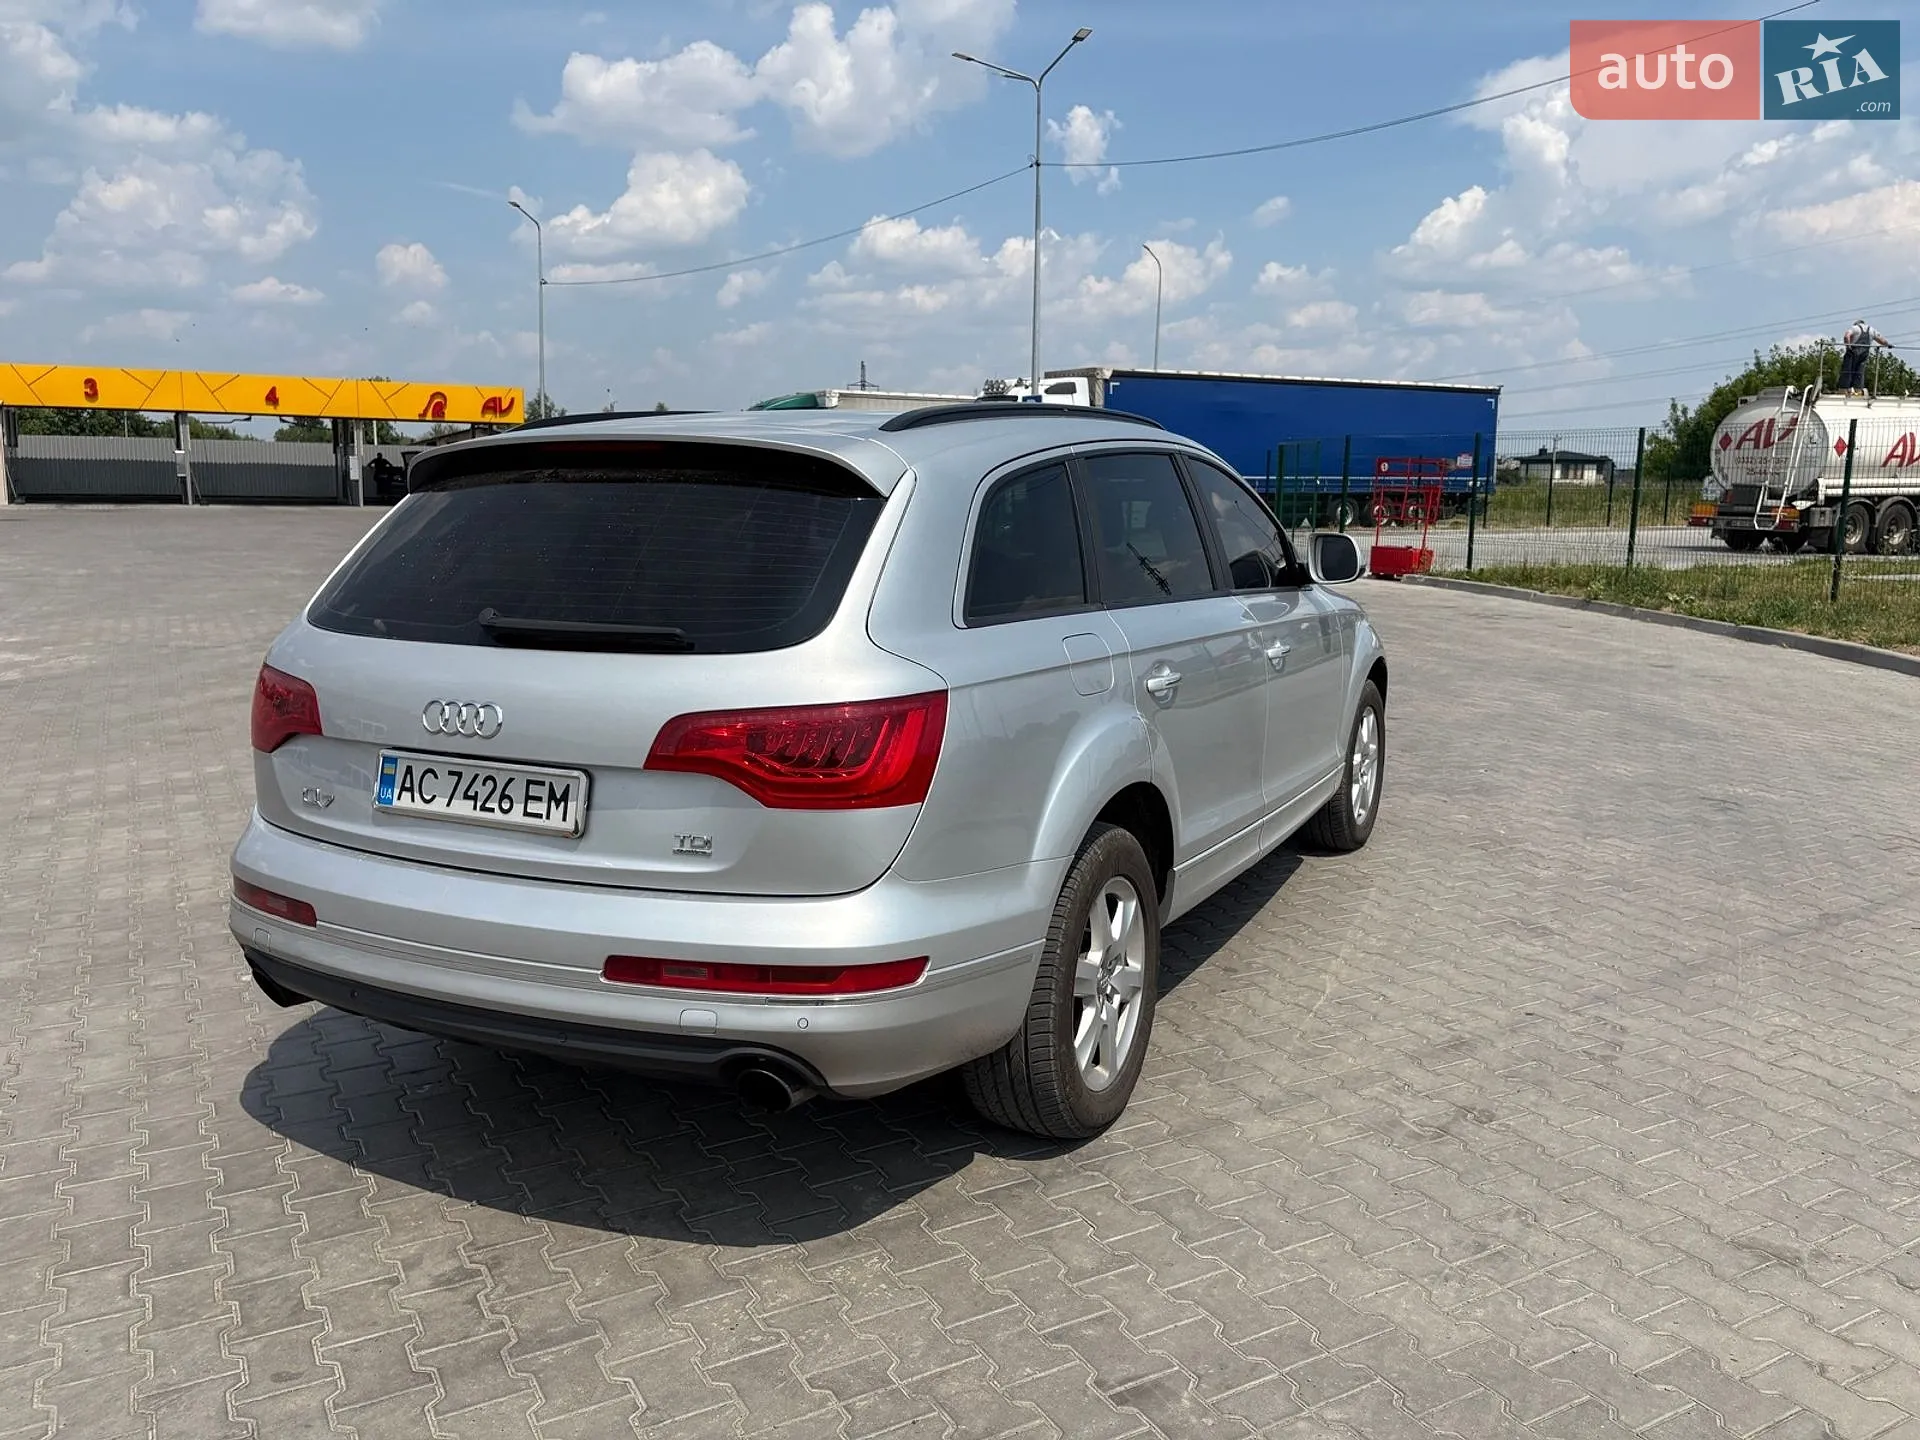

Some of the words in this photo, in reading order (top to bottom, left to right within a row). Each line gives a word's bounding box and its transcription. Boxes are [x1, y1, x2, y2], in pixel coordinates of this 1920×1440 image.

[84, 378, 99, 403] 3
[265, 386, 280, 409] 4
[380, 787, 393, 799] UA
[396, 765, 439, 804] AC
[445, 770, 516, 814] 7426
[522, 779, 571, 822] EM
